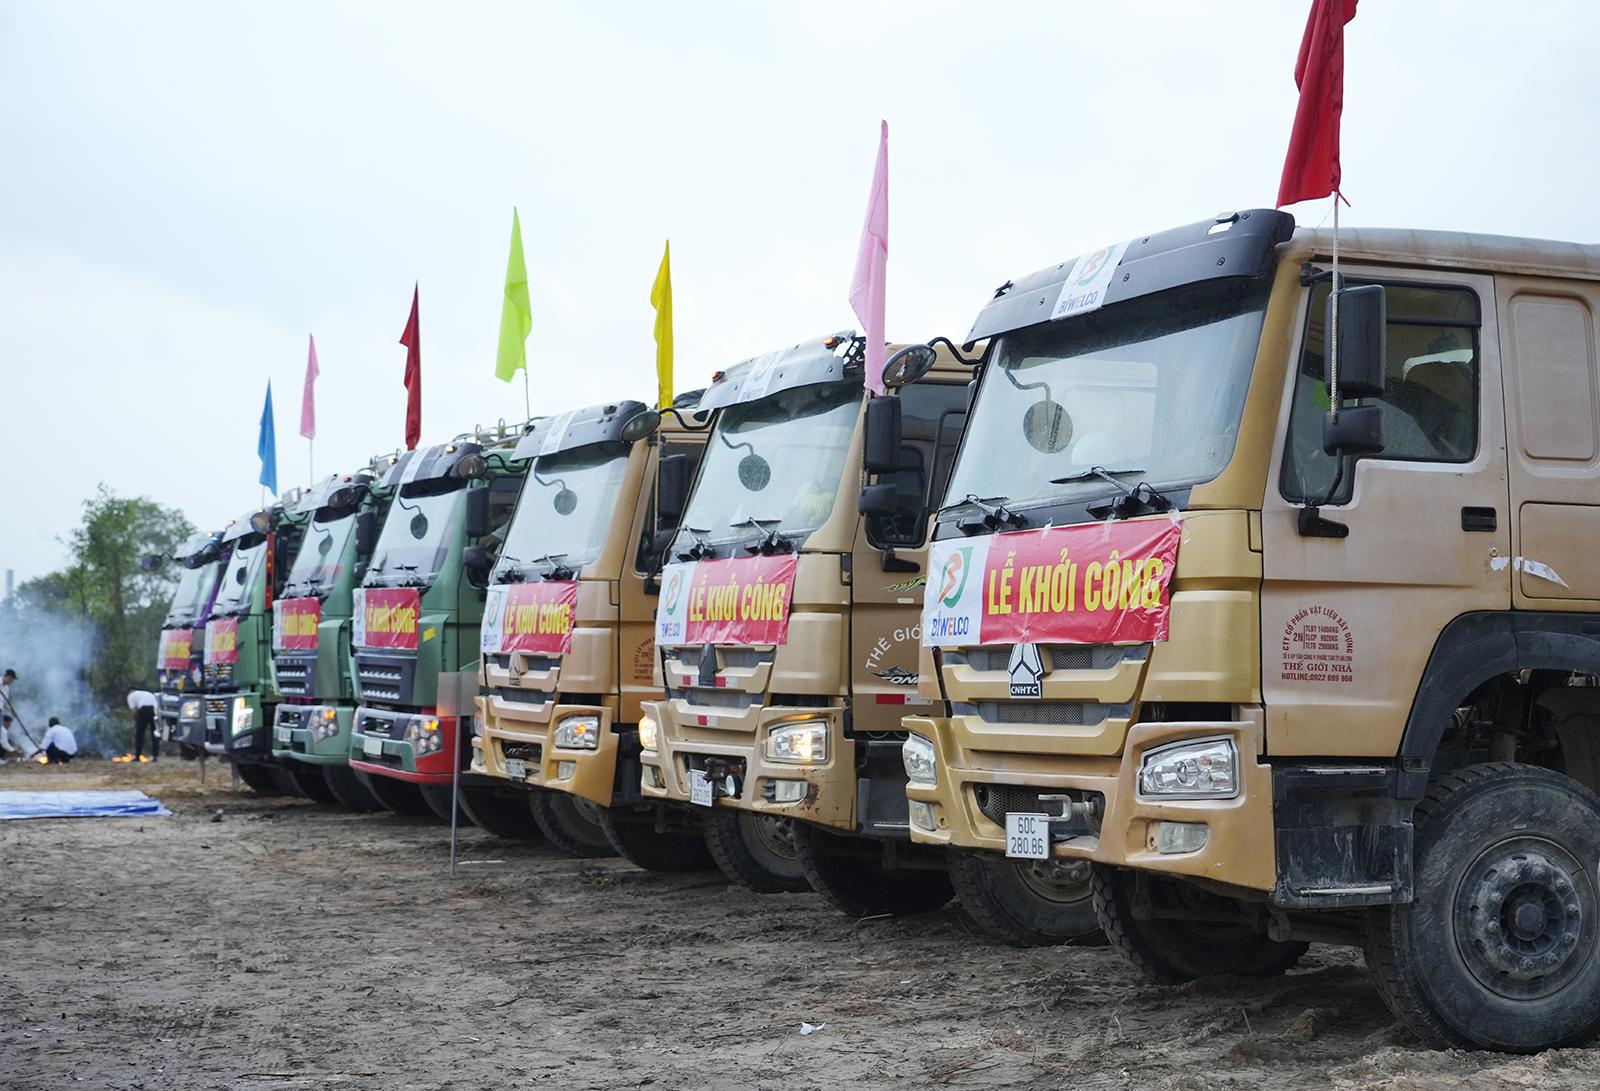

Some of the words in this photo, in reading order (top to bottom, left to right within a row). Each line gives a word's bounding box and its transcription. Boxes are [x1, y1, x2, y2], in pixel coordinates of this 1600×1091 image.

[988, 549, 1014, 615] LỄ
[1018, 547, 1078, 614] KHỞI
[1084, 550, 1165, 611] CÔNG
[689, 573, 708, 622] LỄ
[706, 572, 739, 621] KHỞI
[741, 575, 786, 621] CÔNG
[504, 594, 518, 634] LỄ
[539, 597, 570, 635] CÔNG
[1309, 605, 1322, 616] VẬT
[1323, 607, 1338, 620] LIỆU
[1283, 660, 1304, 670] THẾ
[1307, 661, 1329, 672] GIỚI
[1331, 663, 1352, 672] NHÀ
[1010, 686, 1038, 694] CNHTC
[1017, 816, 1036, 834] 60C
[1011, 836, 1044, 855] 280.86
